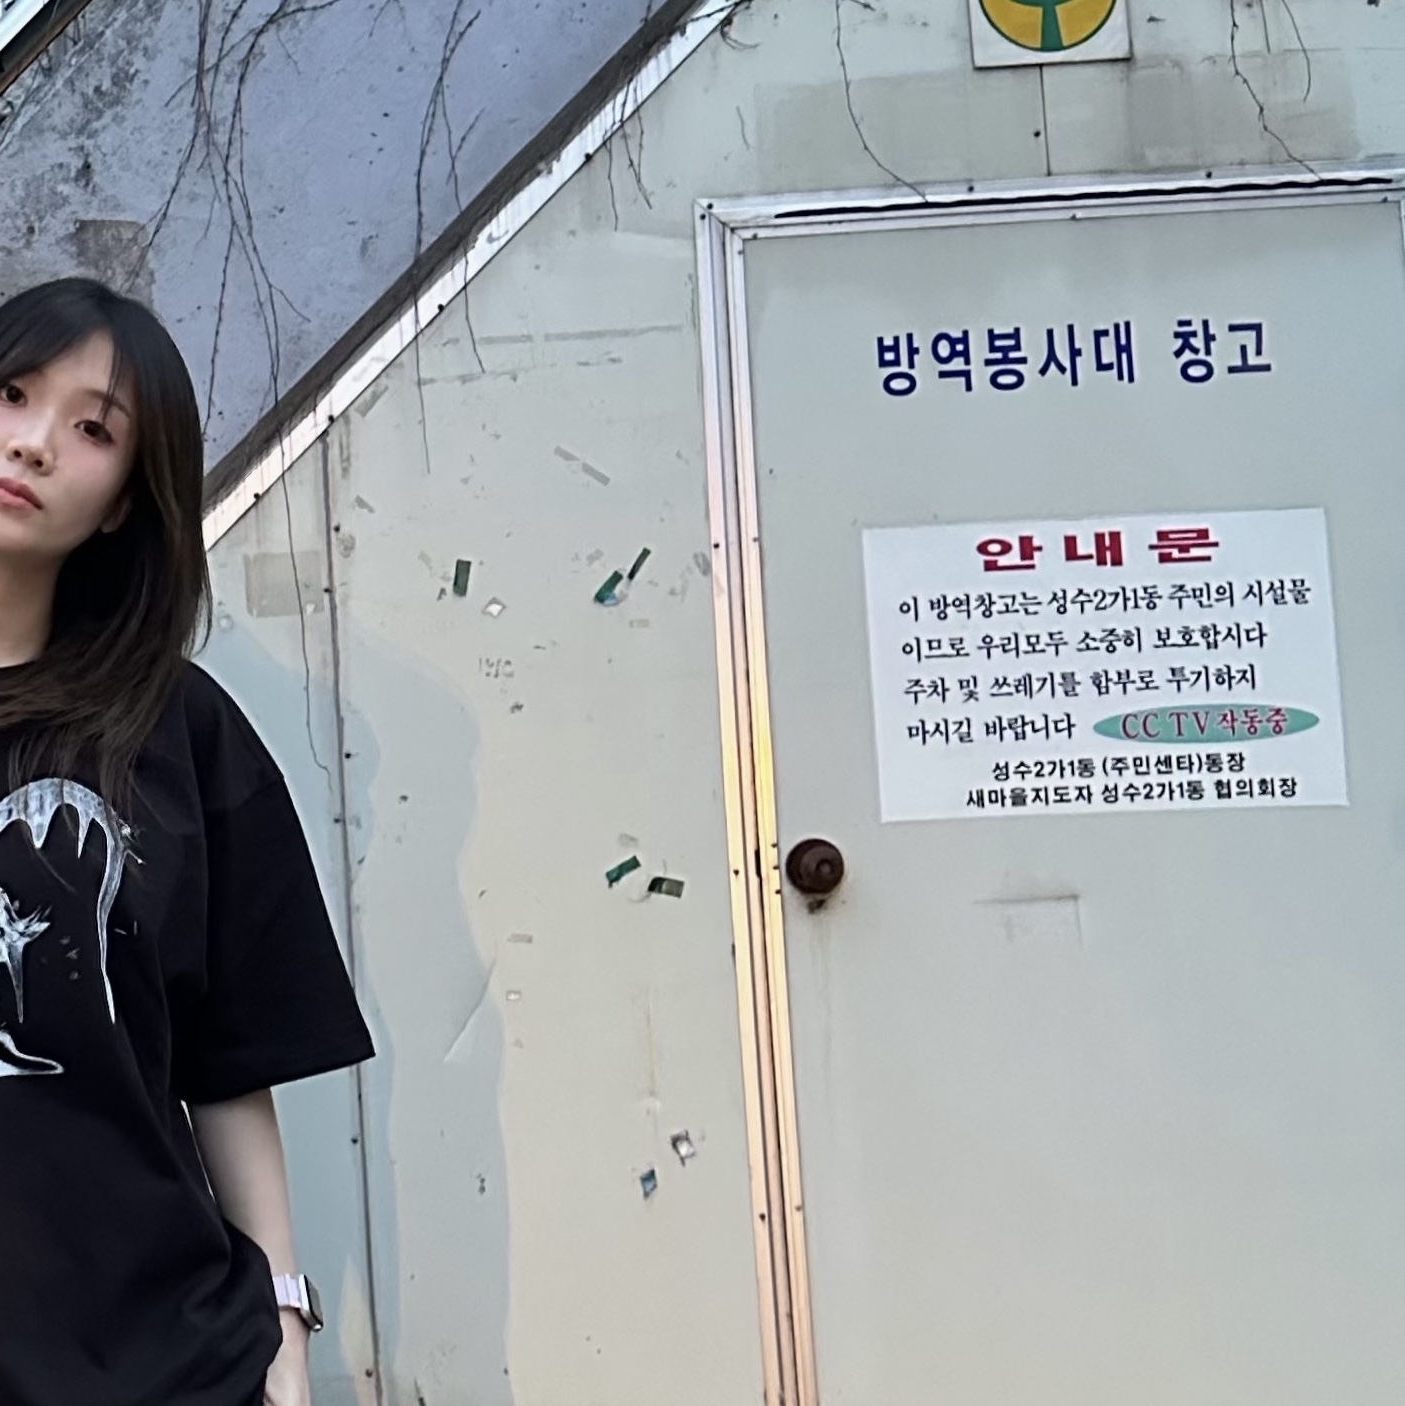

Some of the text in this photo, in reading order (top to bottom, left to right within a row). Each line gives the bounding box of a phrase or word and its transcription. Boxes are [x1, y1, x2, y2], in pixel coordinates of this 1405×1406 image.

[876, 318, 1272, 397] 방역봉사대 창고
[898, 578, 1312, 623] 이 방역창고는 성수2가1동 주민의 시설물
[901, 621, 1268, 663] 이므로 우리모두 소중히 보호합시다
[904, 676, 950, 705] 주차
[957, 675, 979, 703] 및
[989, 671, 1082, 700] 쓰레기를
[1089, 668, 1160, 697] 함부로
[907, 712, 1076, 746] 마시길 바랍니다
[992, 758, 1096, 782] 성수2가1동
[966, 777, 1298, 809] 새마을지도자 성수2가1동 협의회장
